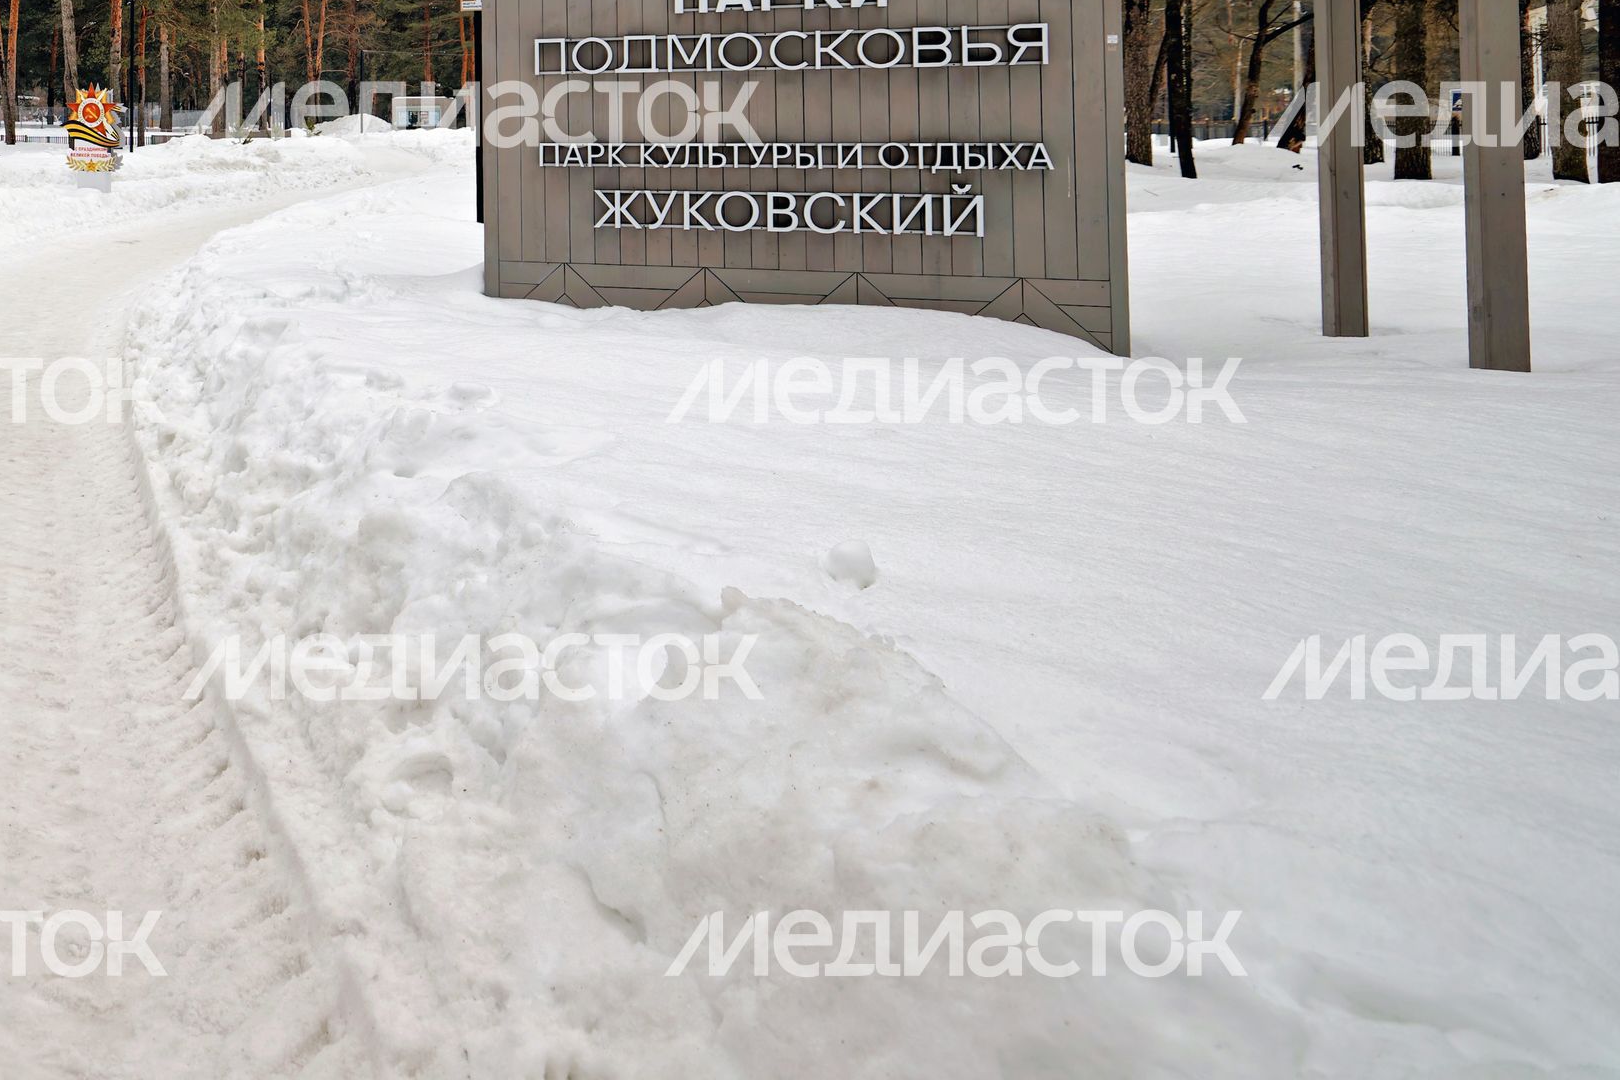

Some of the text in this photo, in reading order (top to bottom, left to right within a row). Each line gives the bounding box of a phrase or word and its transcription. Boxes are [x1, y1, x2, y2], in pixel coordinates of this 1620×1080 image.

[534, 23, 1048, 75] ПОДМОСКОВЬЯ
[539, 142, 1055, 174] ПАРК КУЛЬТУРЫ И ОТДЫХА
[594, 183, 984, 238] ЖУКОВСКИЙ
